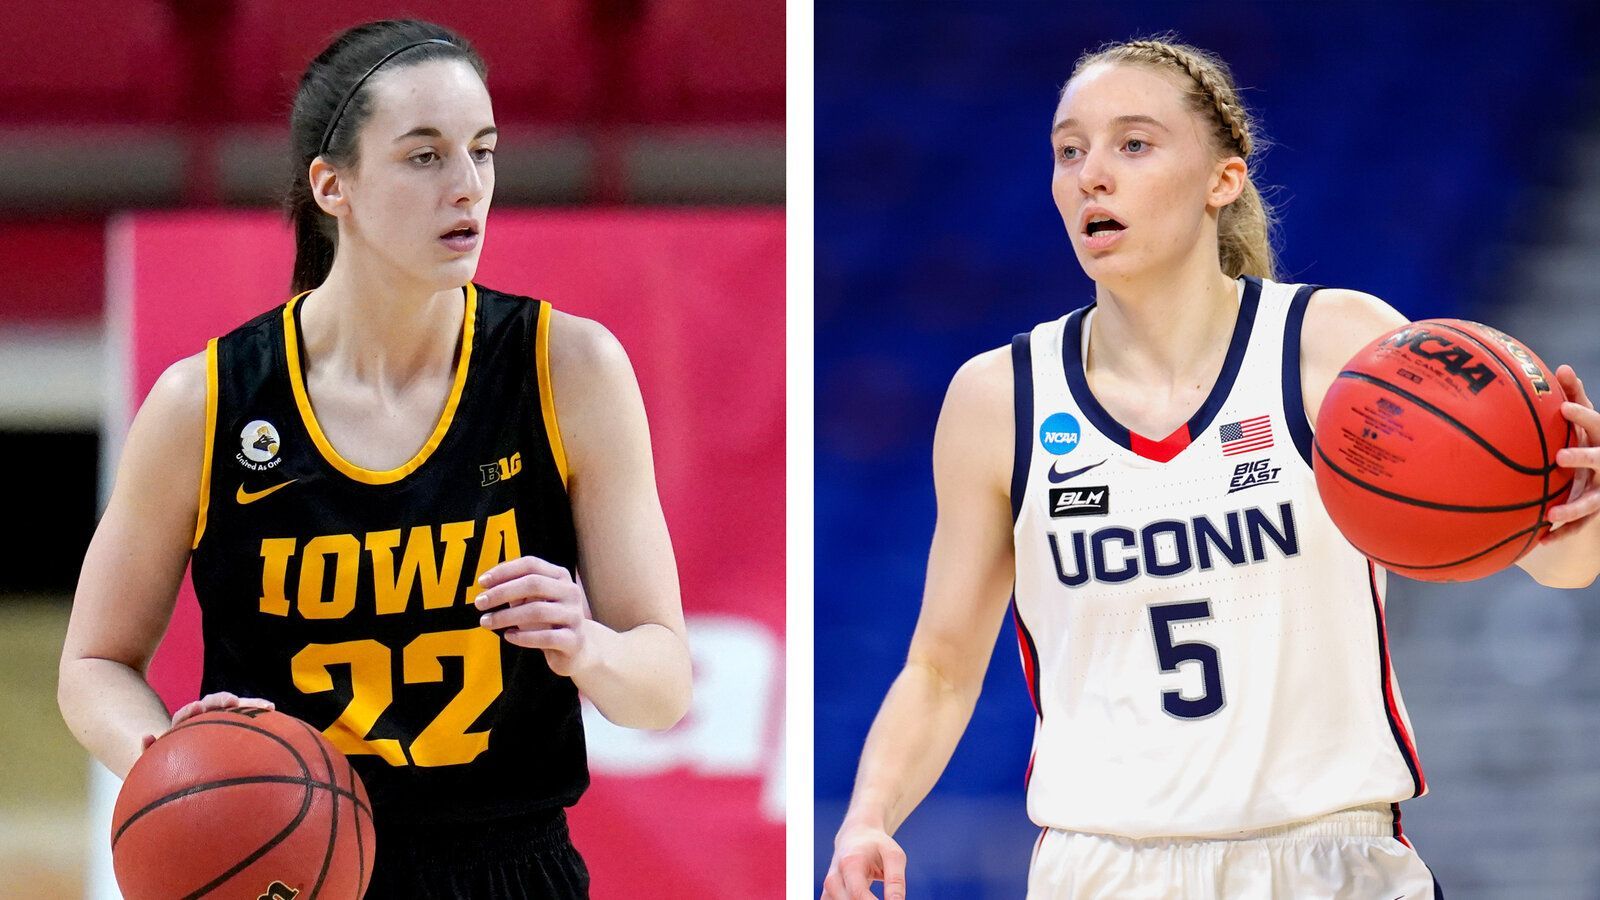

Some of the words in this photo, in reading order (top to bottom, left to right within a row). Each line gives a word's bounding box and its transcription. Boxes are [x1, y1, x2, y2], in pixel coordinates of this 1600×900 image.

[1377, 328, 1498, 396] NCAA
[1044, 432, 1078, 444] NCAA
[235, 453, 257, 470] United
[267, 457, 282, 469] One
[1230, 468, 1282, 488] EAST
[1233, 458, 1271, 476] BIG
[1056, 490, 1105, 506] BLM
[259, 508, 522, 620] IOWA
[1047, 500, 1301, 588] UCONN
[1146, 597, 1228, 721] 5
[291, 626, 504, 767] 22
